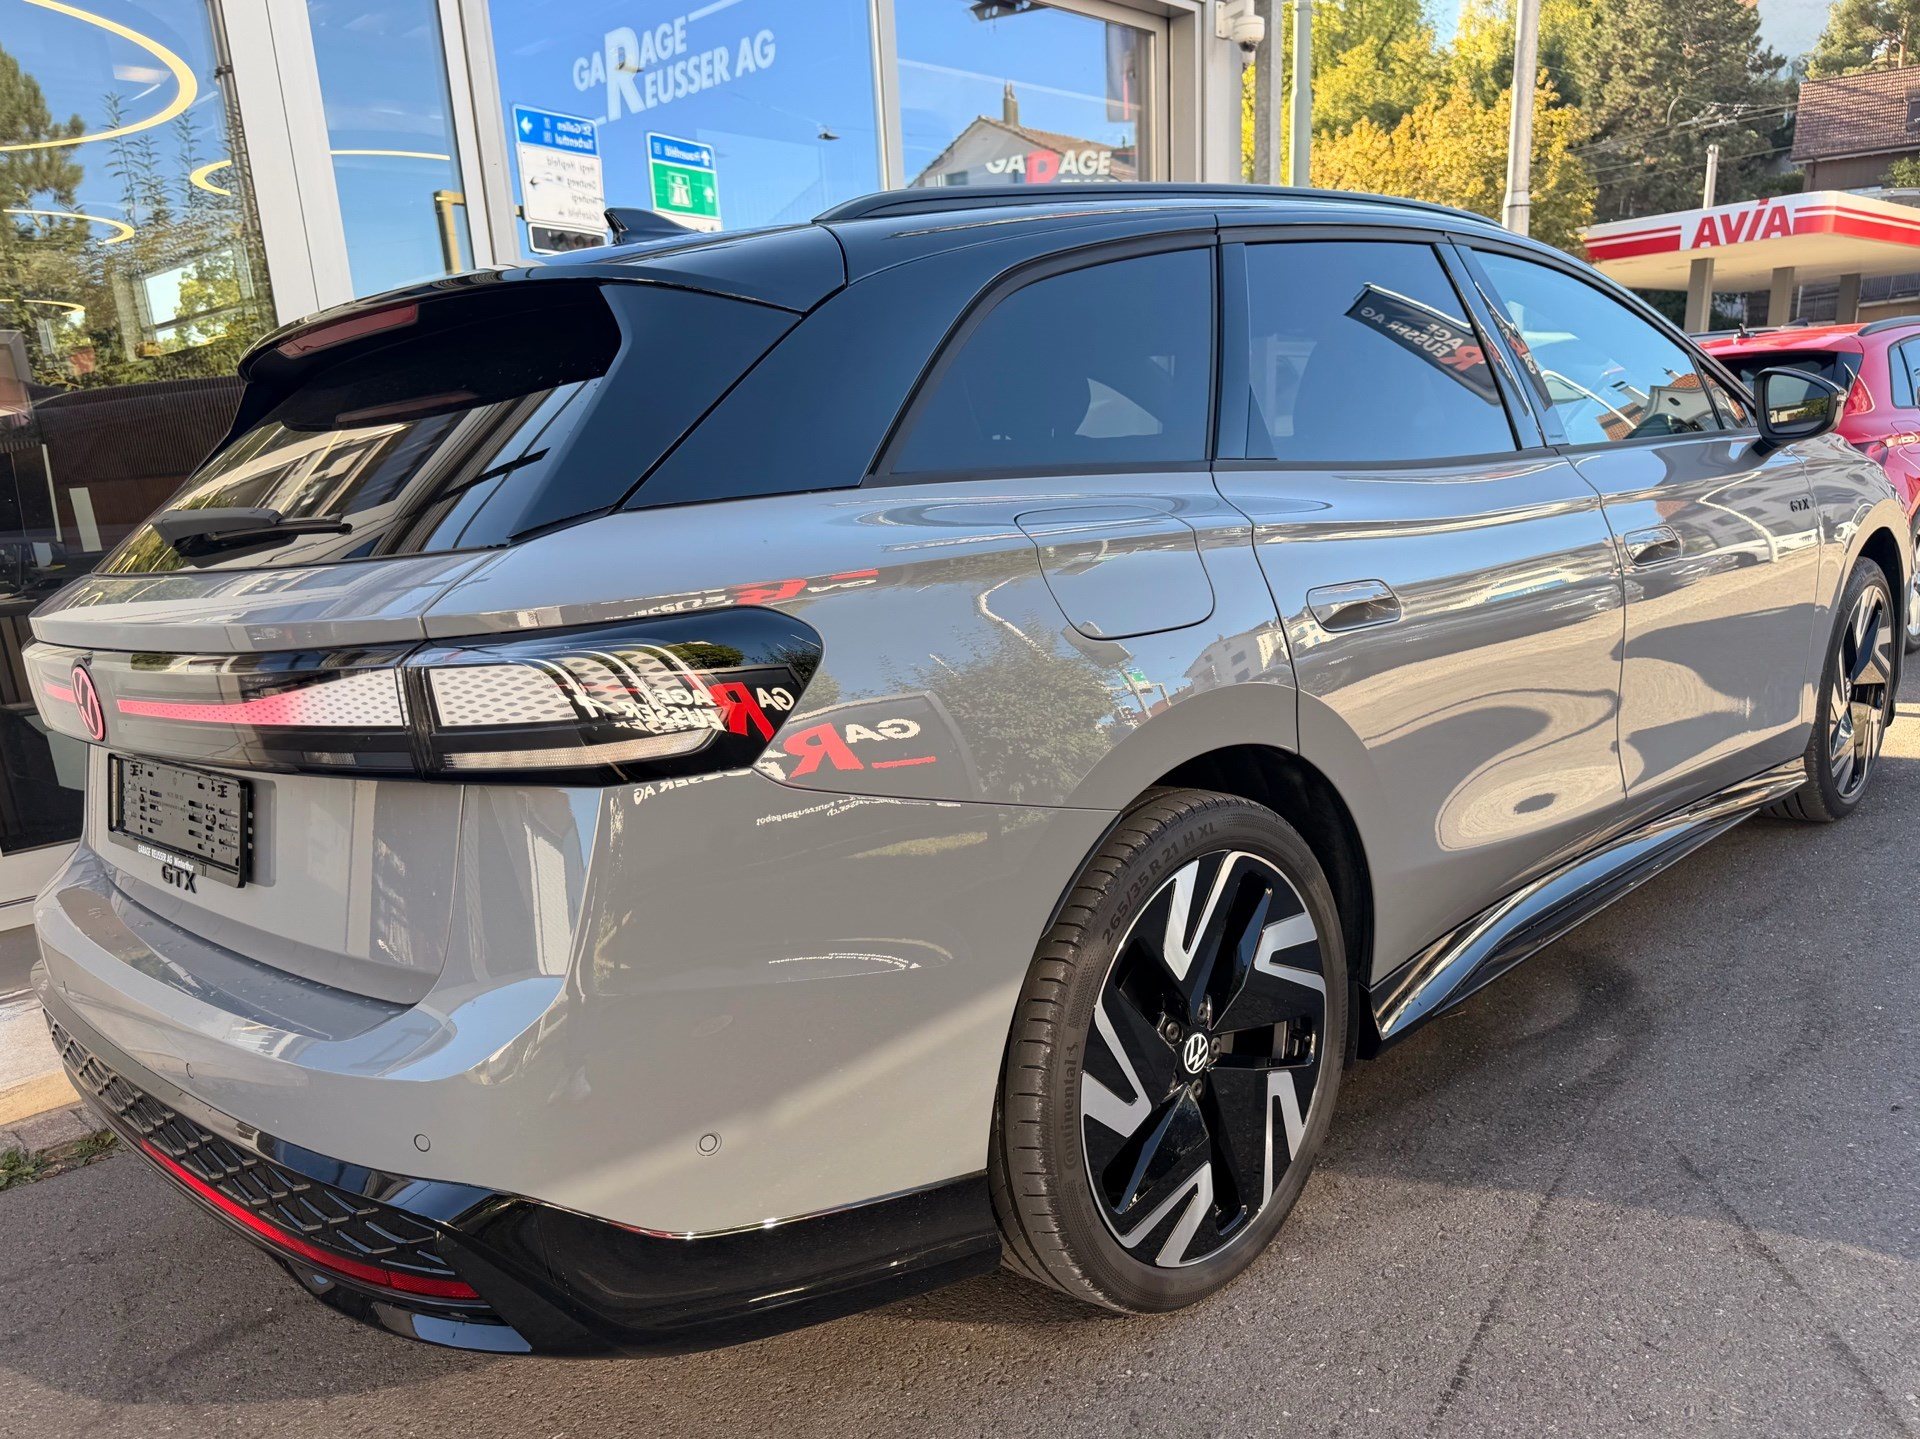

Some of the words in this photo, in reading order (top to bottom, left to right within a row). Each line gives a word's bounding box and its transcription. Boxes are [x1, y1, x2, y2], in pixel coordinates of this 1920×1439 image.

[735, 29, 776, 77] AG
[1691, 198, 1794, 250] AVIA
[137, 844, 151, 857] GARAGE
[166, 853, 173, 865] AG
[162, 863, 197, 894] GTX
[1102, 871, 1150, 946] 265/35
[1148, 858, 1161, 875] R
[1162, 841, 1181, 861] 21
[1183, 830, 1196, 847] H
[1198, 822, 1219, 836] XL
